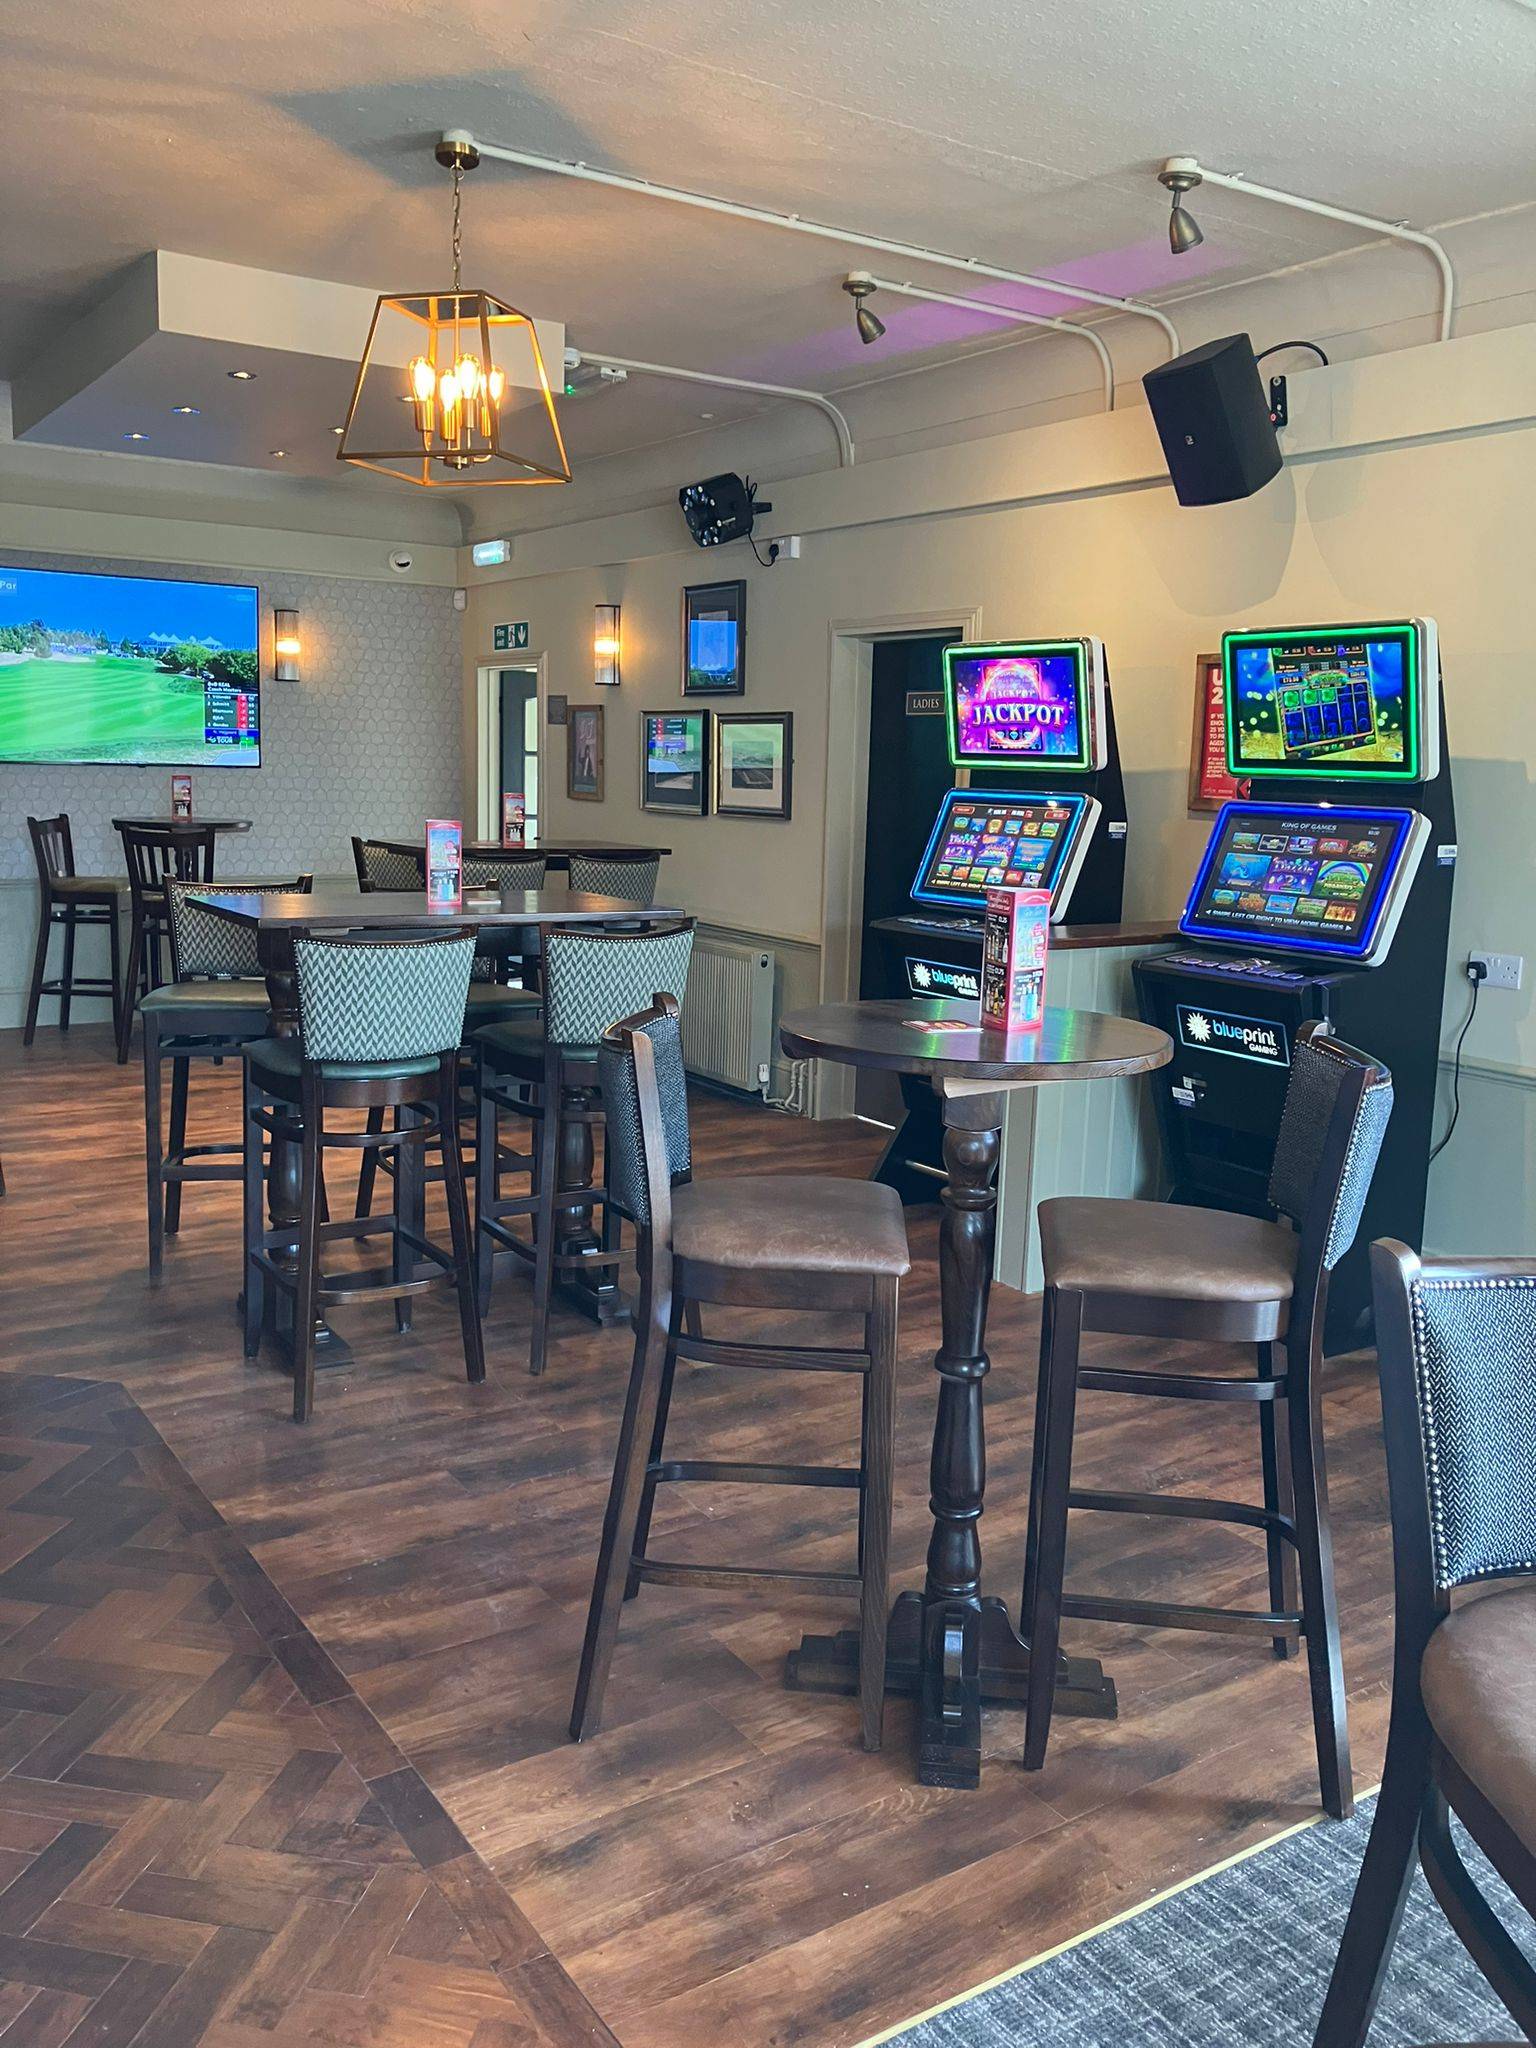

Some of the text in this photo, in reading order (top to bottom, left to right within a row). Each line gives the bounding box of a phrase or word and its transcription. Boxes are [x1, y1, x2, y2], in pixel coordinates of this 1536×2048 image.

[913, 698, 940, 709] LADIES
[972, 703, 1065, 727] JACKPOT
[1320, 922, 1344, 931] GAMES
[931, 968, 978, 990] blueprint
[1212, 1019, 1276, 1047] blueprint
[1248, 1043, 1278, 1056] GAMING
